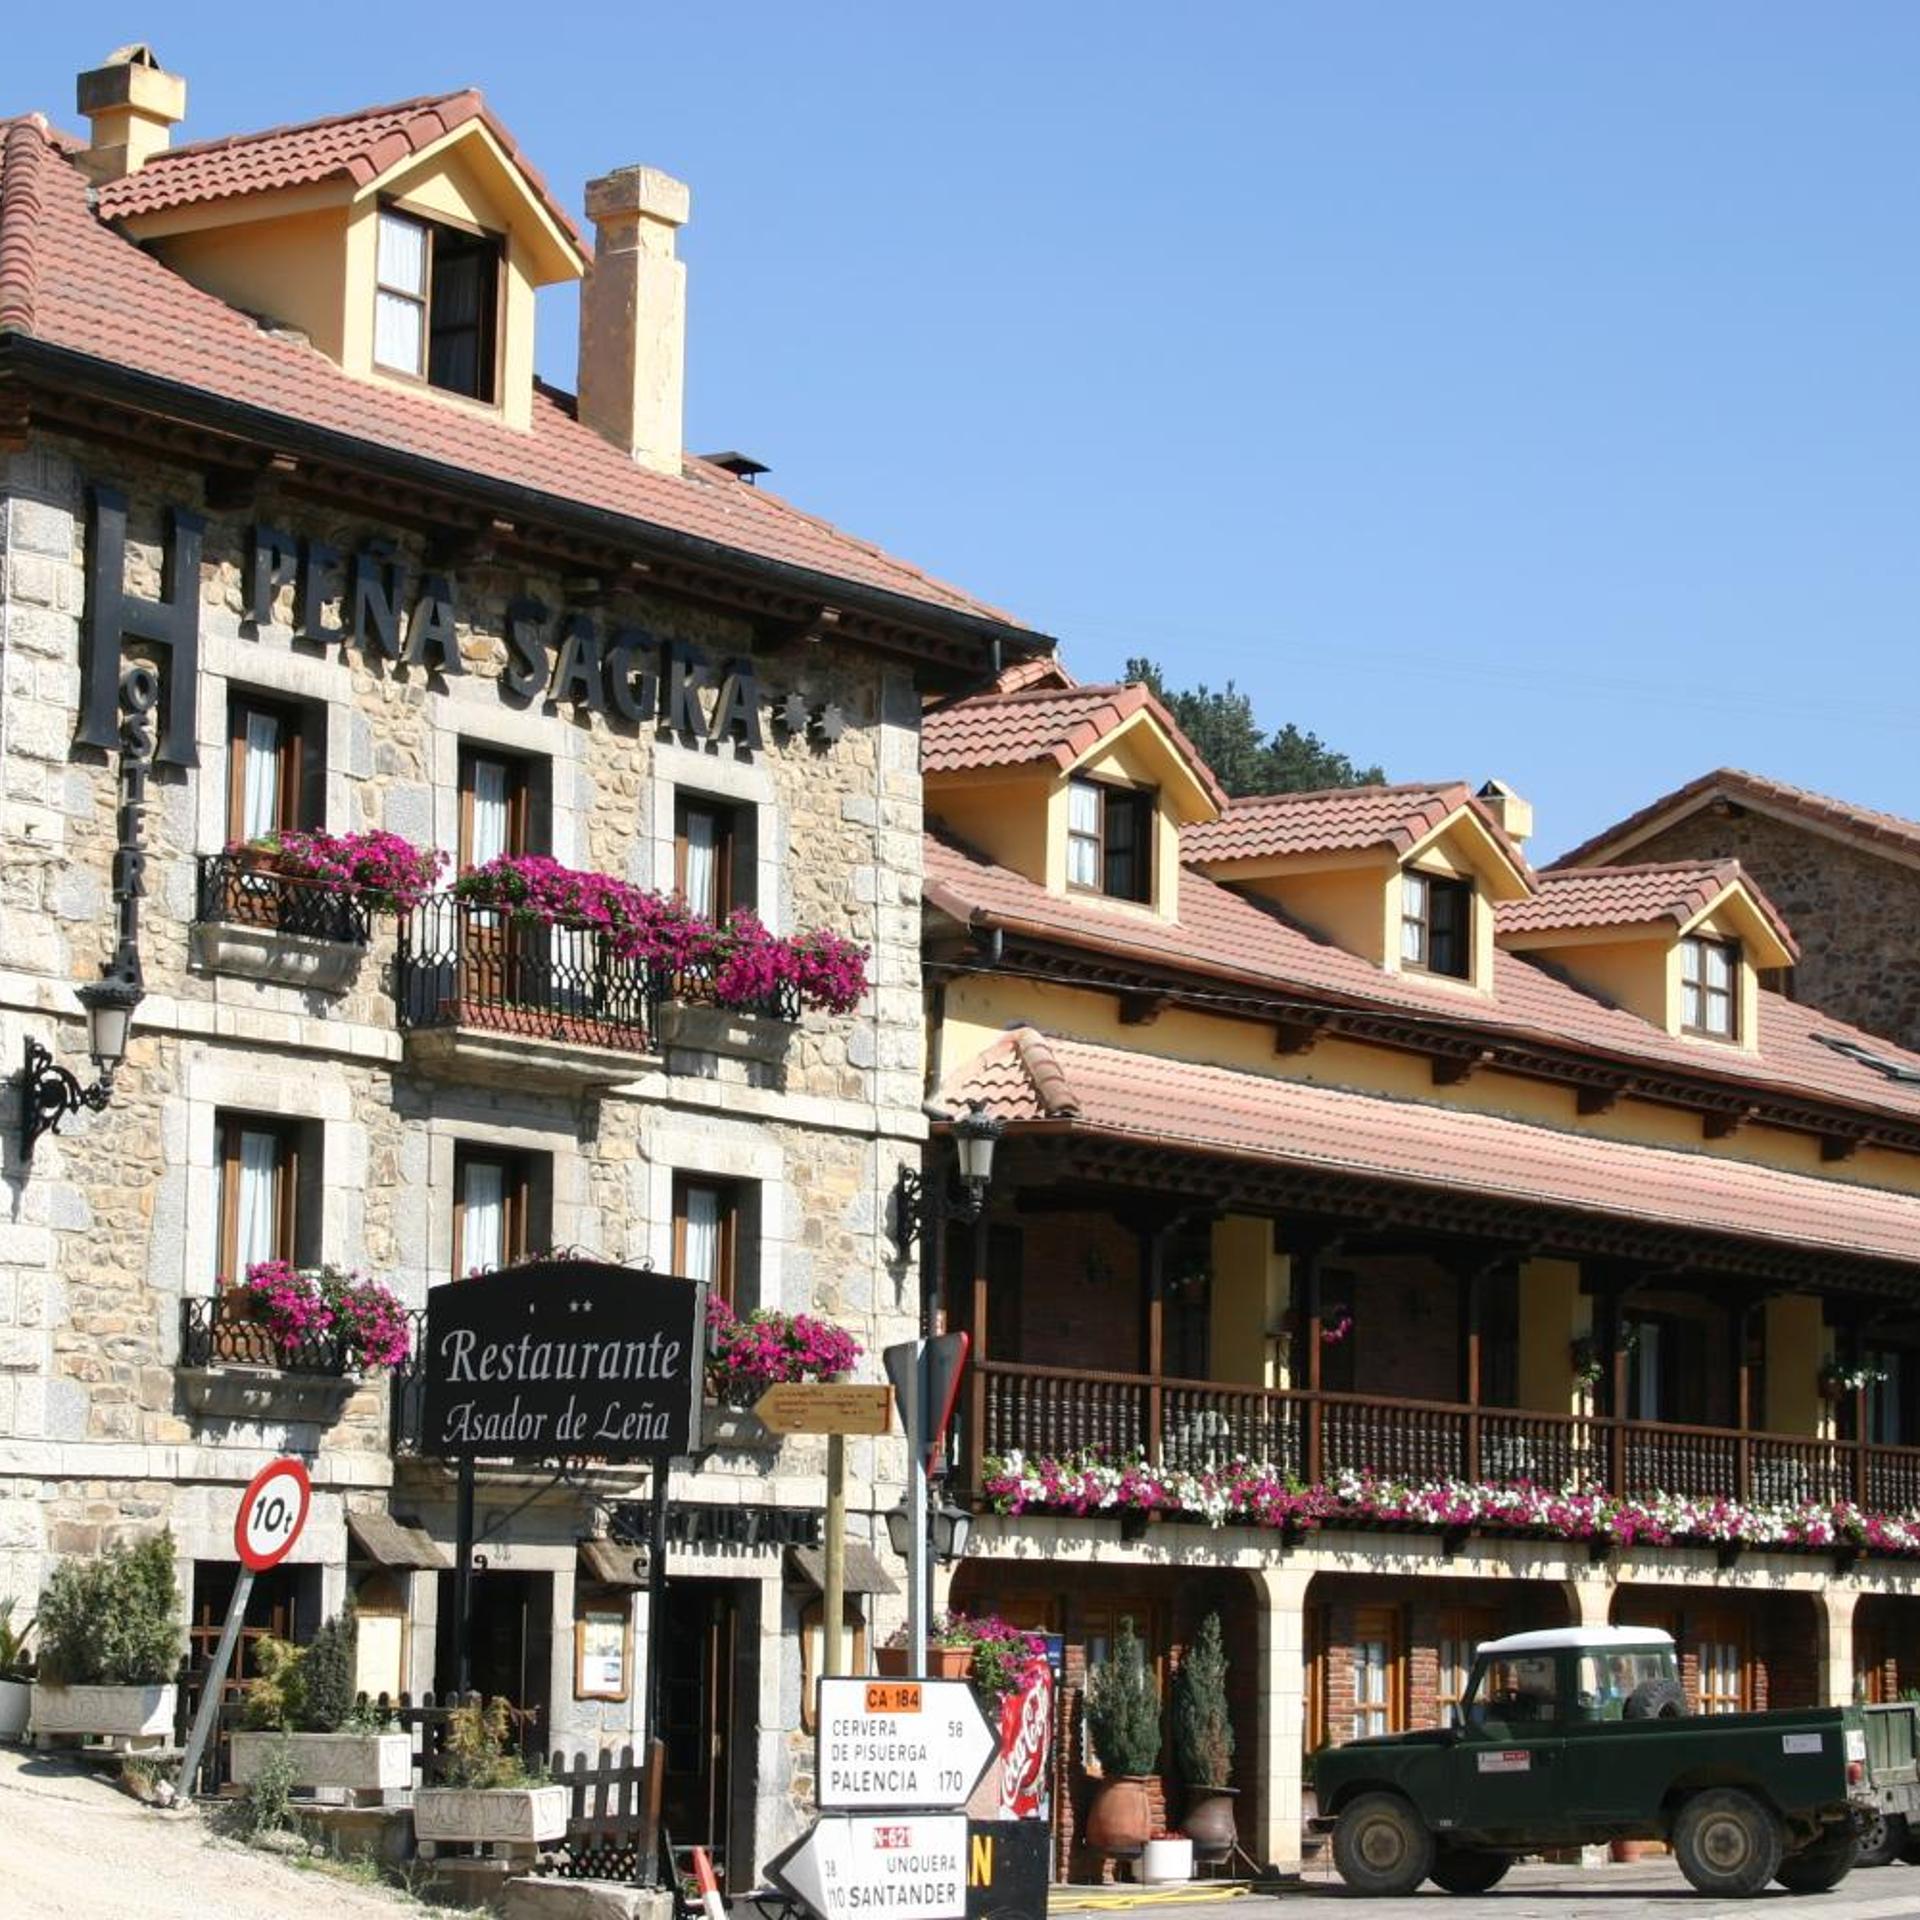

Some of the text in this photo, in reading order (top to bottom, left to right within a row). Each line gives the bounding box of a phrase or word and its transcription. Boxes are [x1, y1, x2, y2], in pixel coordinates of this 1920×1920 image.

[245, 523, 763, 750] PEÑA SAGRA
[441, 1329, 680, 1382] Restaurante
[442, 1394, 670, 1443] Asador de Leña
[832, 1719, 897, 1737] CERVERA
[831, 1744, 927, 1761] DE PISUERGA
[831, 1770, 963, 1793] PALENCIA 170
[887, 1854, 957, 1874] UNQUERA
[849, 1882, 956, 1908] SANTANDER
